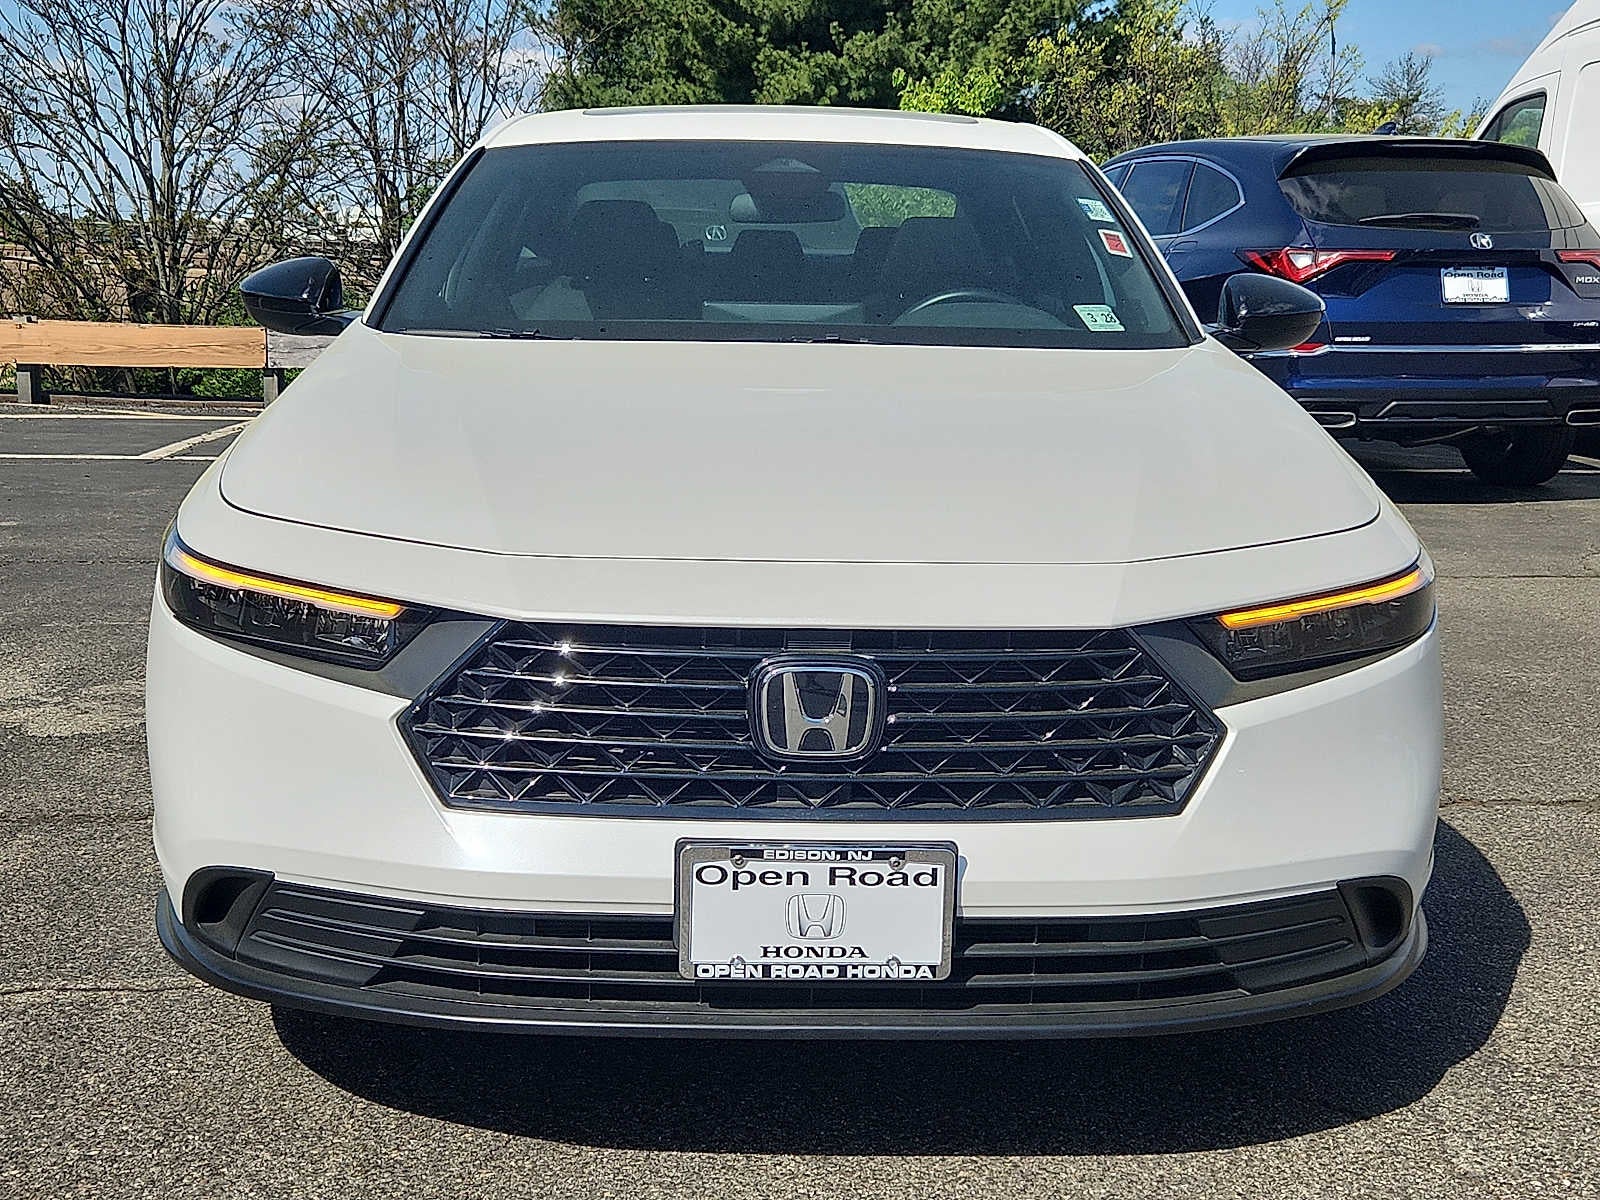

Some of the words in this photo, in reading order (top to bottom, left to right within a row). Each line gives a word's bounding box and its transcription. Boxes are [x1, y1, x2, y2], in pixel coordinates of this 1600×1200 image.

[1575, 276, 1600, 284] MDX
[763, 850, 840, 861] EDISON,
[847, 851, 873, 861] NJ
[695, 865, 810, 891] Open
[828, 866, 938, 887] Road
[760, 945, 869, 959] HONDA
[696, 964, 763, 979] OPEN
[770, 965, 839, 979] ROAD
[847, 965, 933, 979] HONDA
